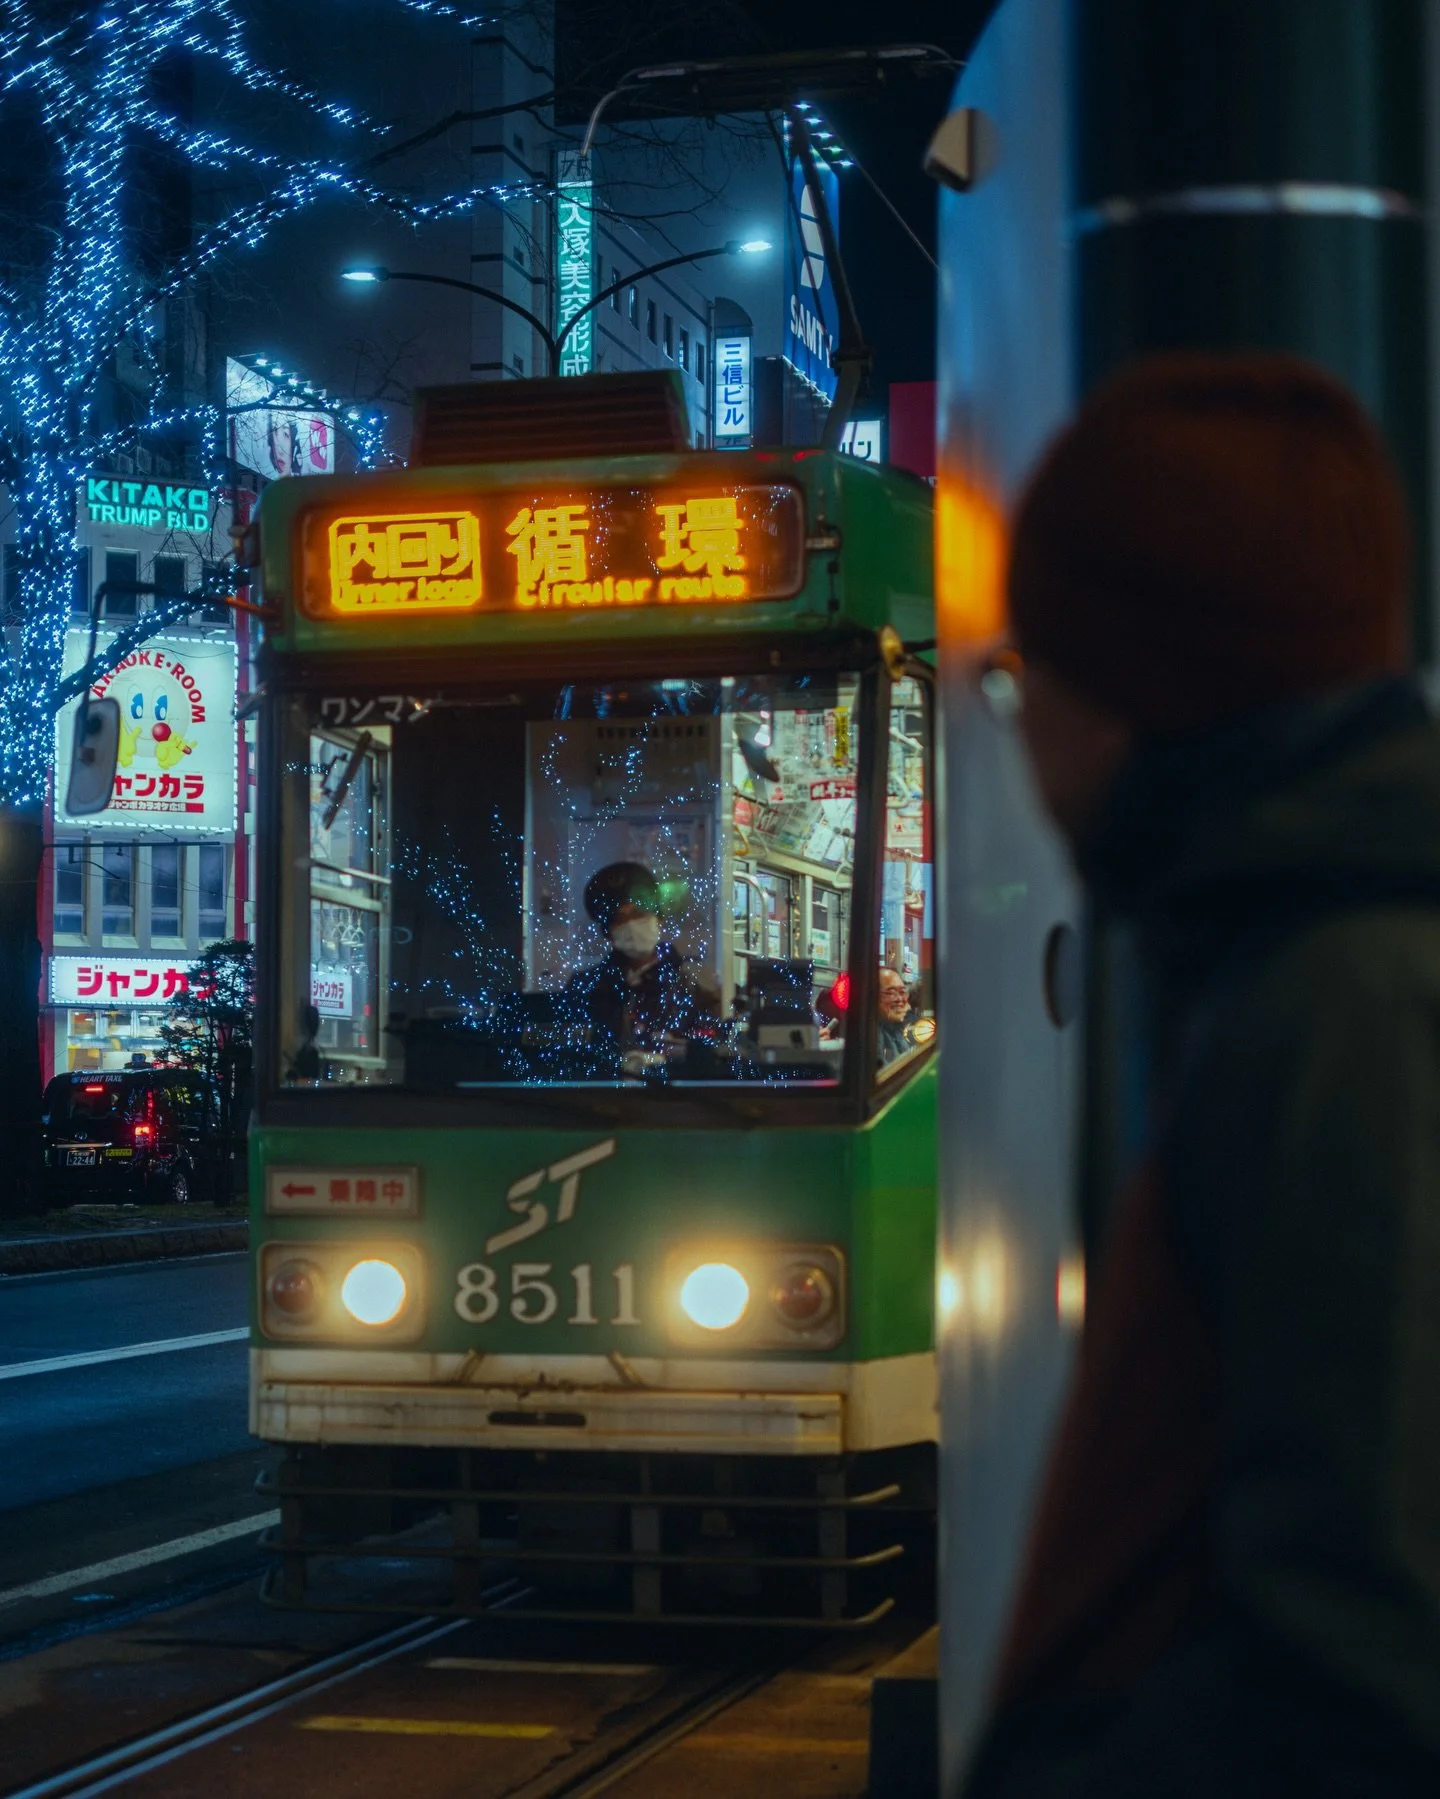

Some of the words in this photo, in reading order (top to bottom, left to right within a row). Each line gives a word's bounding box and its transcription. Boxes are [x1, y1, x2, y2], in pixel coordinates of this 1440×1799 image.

[790, 295, 834, 369] SAMTY
[722, 344, 744, 426] 三信ビル
[88, 478, 209, 512] KITAKO
[88, 503, 161, 527] TRUMP
[338, 520, 475, 579] 内回り
[321, 695, 433, 724] ワンマン
[113, 773, 205, 799] ャンカラ
[454, 1263, 642, 1325] 8511
